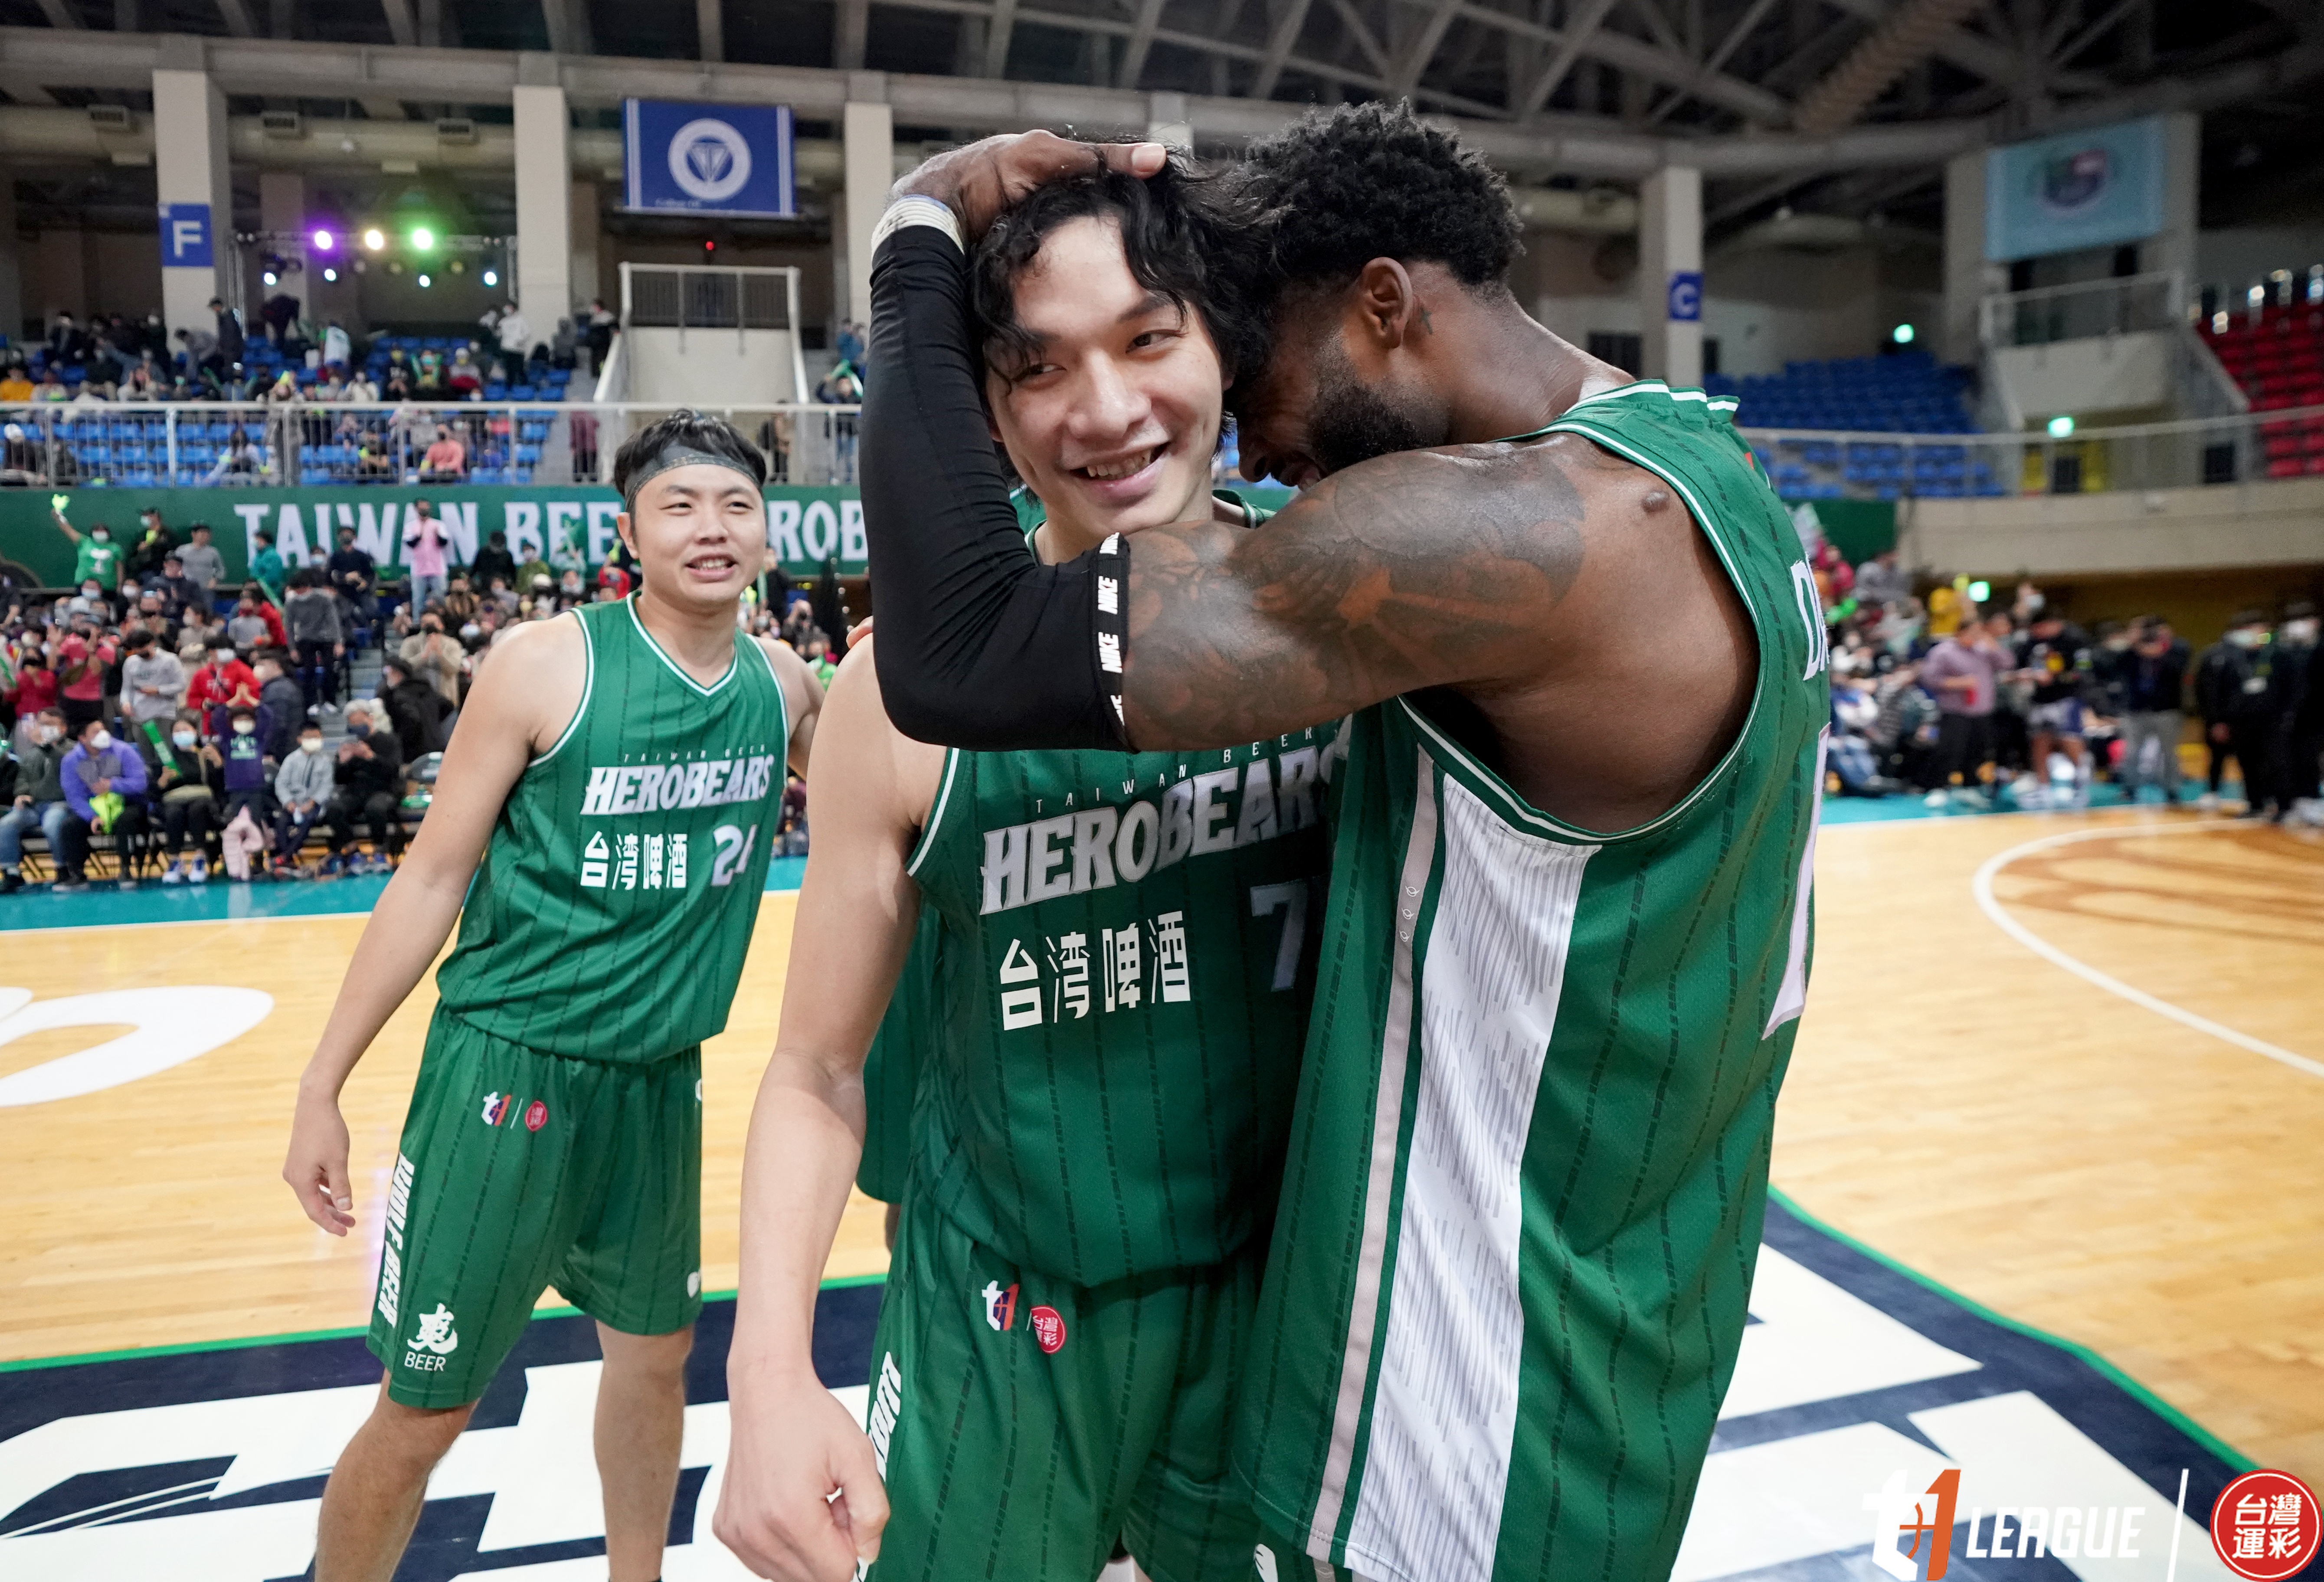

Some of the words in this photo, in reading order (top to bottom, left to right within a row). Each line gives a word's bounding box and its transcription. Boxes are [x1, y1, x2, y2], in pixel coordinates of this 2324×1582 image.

[173, 220, 202, 258] F
[1672, 282, 1699, 316] C
[503, 501, 622, 566] BEE
[1098, 575, 1118, 615] NIKE
[1098, 632, 1123, 674] NIKE
[624, 749, 707, 763] TAIWAN
[724, 744, 765, 758] BEER
[1036, 764, 1187, 814] TAIWAN
[1223, 726, 1313, 763] BEER
[579, 754, 775, 815] HEROBEARS
[579, 831, 688, 890] 台湾啤酒
[999, 910, 1191, 1031] 台湾啤酒
[378, 1240, 401, 1328] BEER
[404, 1351, 446, 1372] BEER
